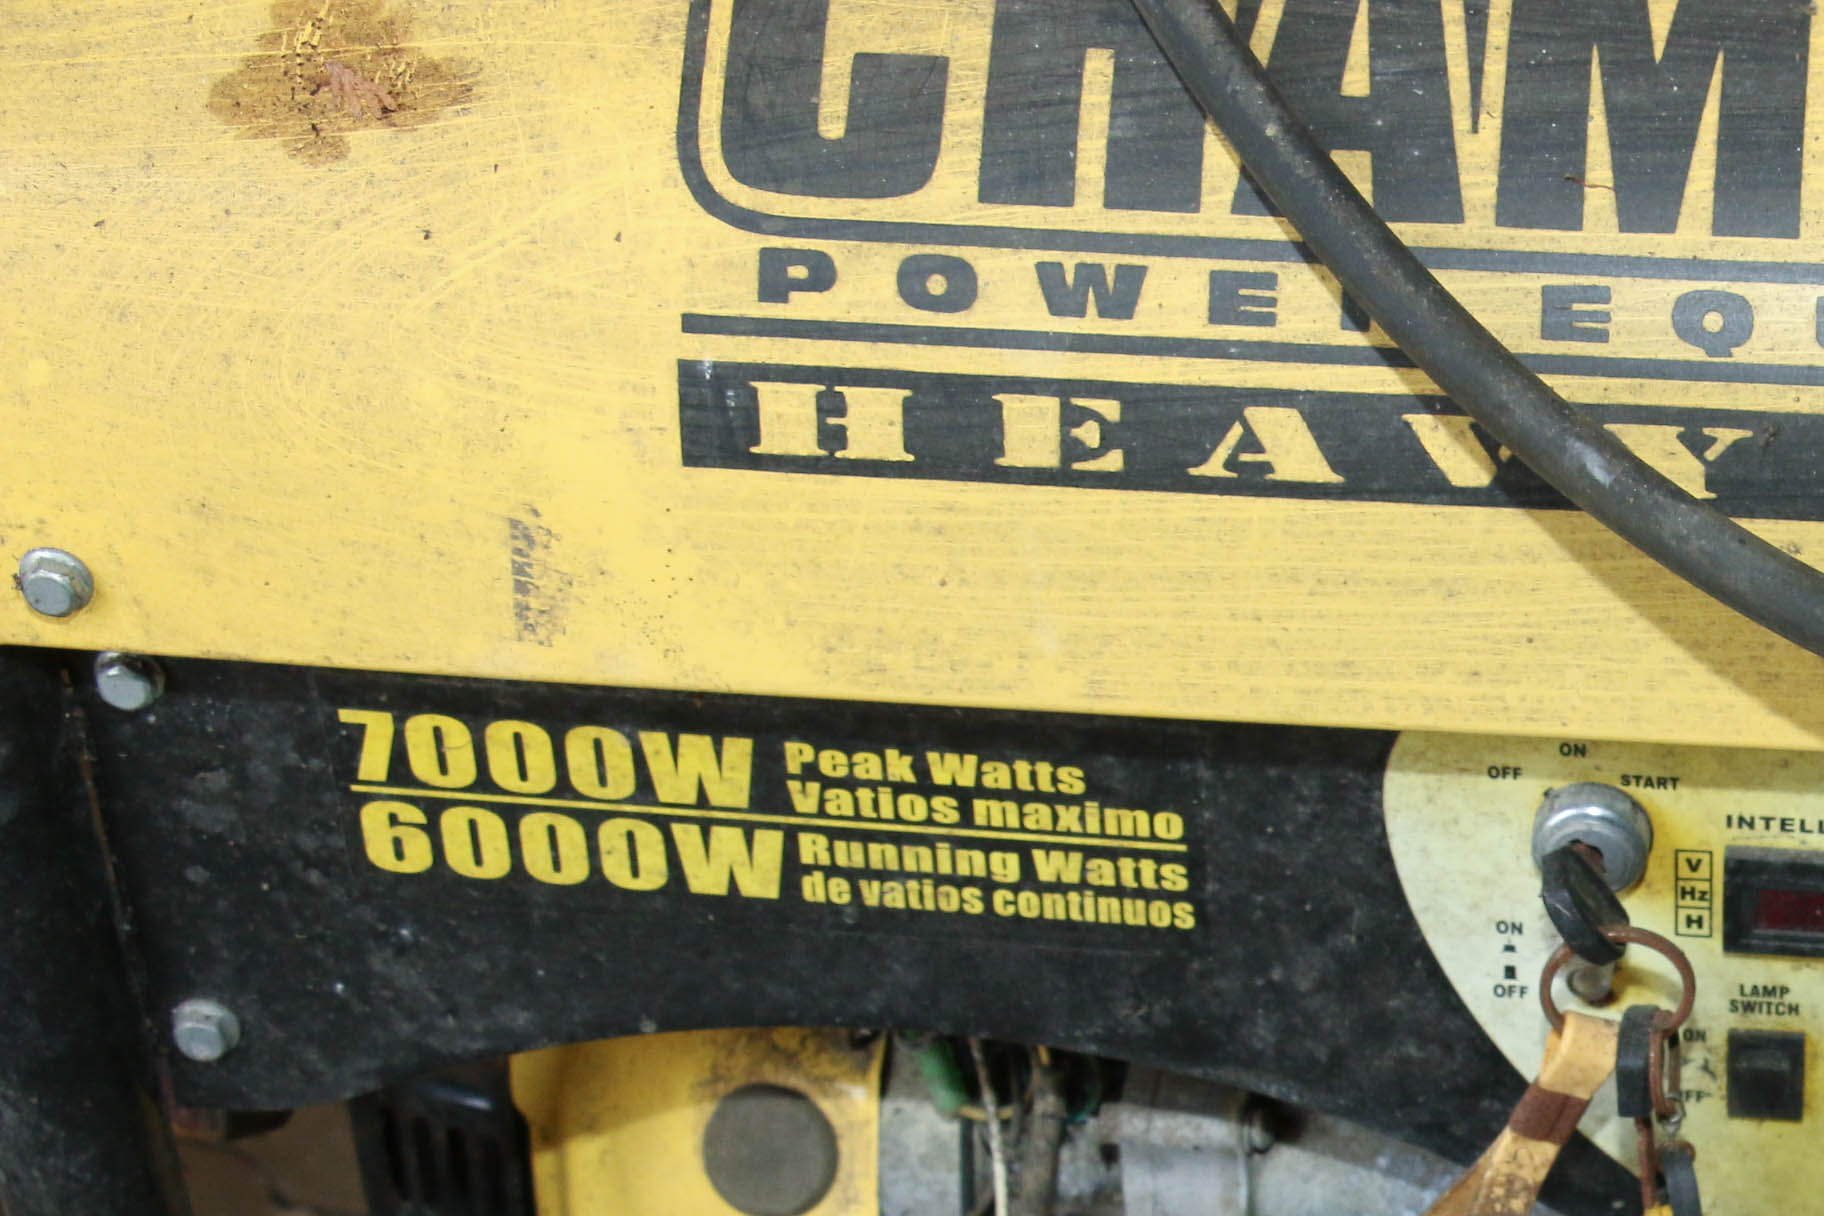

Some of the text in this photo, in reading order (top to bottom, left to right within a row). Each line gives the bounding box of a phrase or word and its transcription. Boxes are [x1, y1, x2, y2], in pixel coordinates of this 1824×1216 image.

[758, 247, 1371, 334] POWE
[337, 708, 754, 808] 7000W
[1559, 743, 1587, 758] ON
[784, 742, 1086, 795] Peak Watts
[1488, 766, 1523, 780] OFF
[1620, 774, 1680, 791] START
[788, 780, 1185, 841] Vatios maximo
[359, 800, 785, 900] 6000W
[798, 833, 1190, 892] Running Watts
[1686, 858, 1702, 872] V
[801, 870, 1196, 930] de vatios continuos
[1680, 886, 1709, 902] Hz
[1496, 921, 1523, 935] ON
[1686, 915, 1703, 929] H
[1494, 985, 1527, 998] OFF
[1739, 985, 1790, 998] LAMP
[1729, 1000, 1800, 1015] SWITCH
[1683, 1028, 1707, 1042] ON
